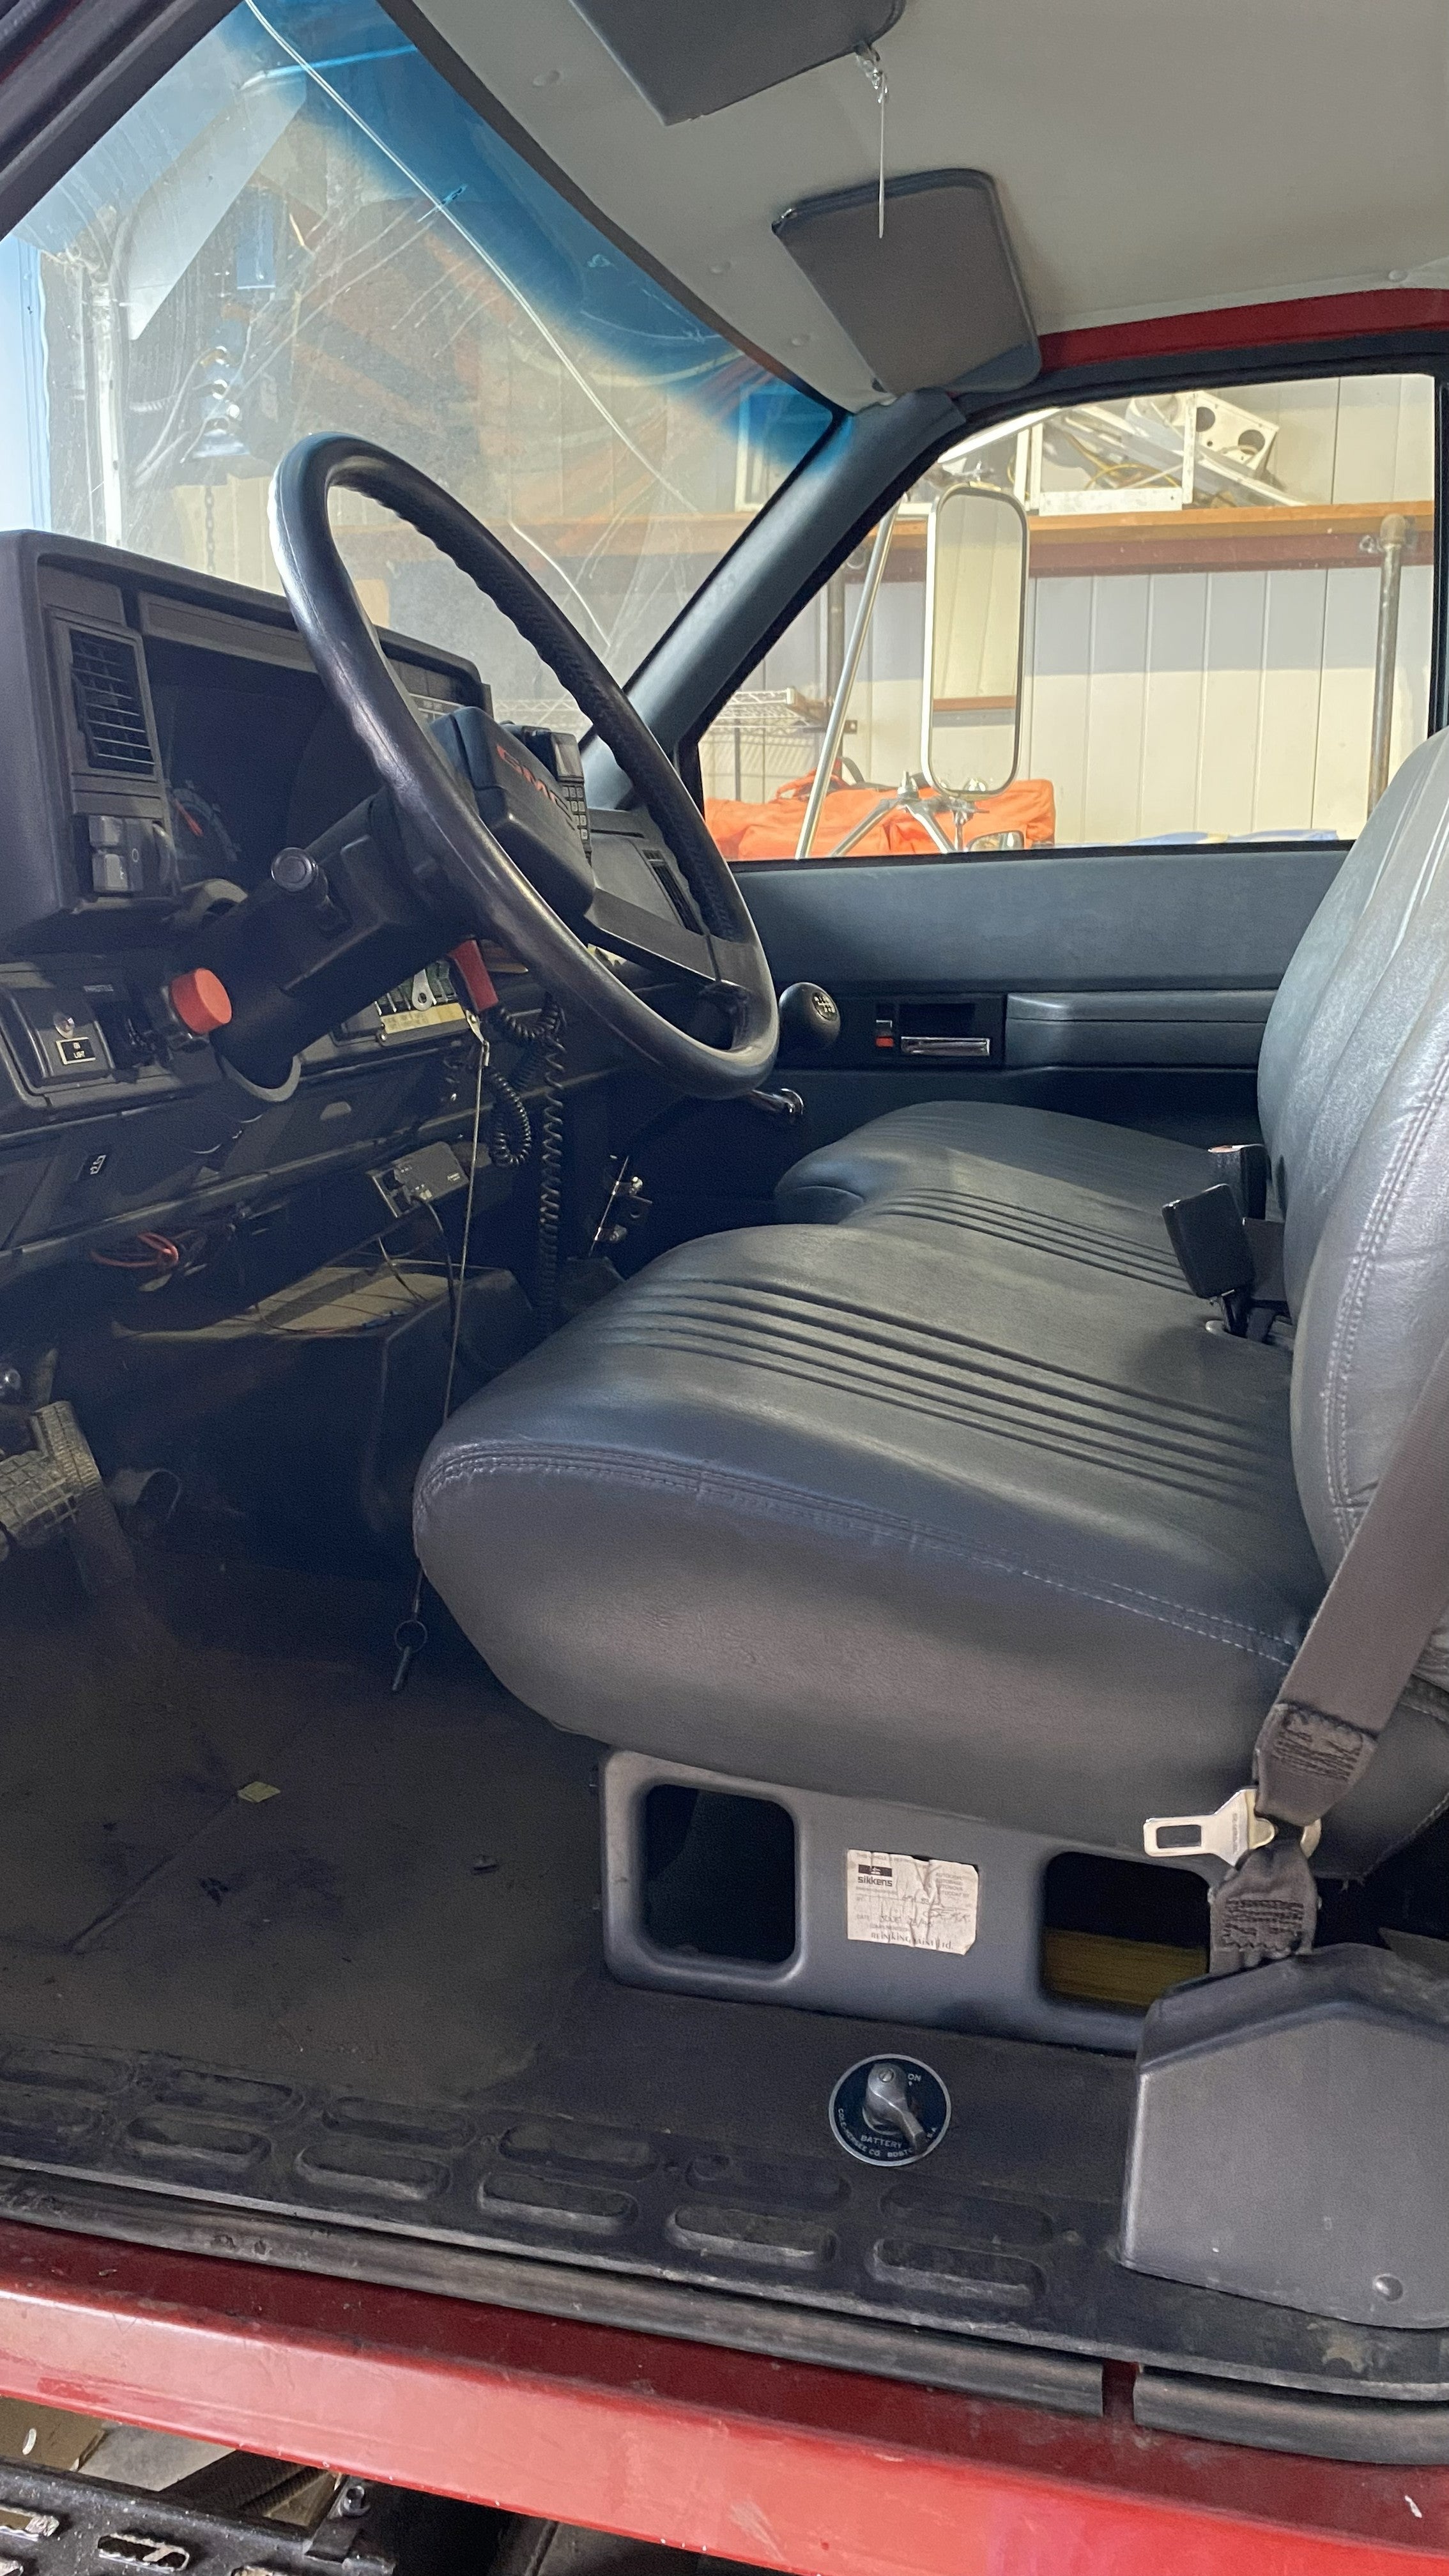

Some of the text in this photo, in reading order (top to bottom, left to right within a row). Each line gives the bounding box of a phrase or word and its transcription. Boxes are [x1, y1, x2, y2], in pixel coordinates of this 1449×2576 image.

[858, 1876, 893, 1887] sikkens
[907, 2073, 921, 2082] ON
[861, 2135, 903, 2149] BATTERY
[887, 2148, 913, 2158] BOST
